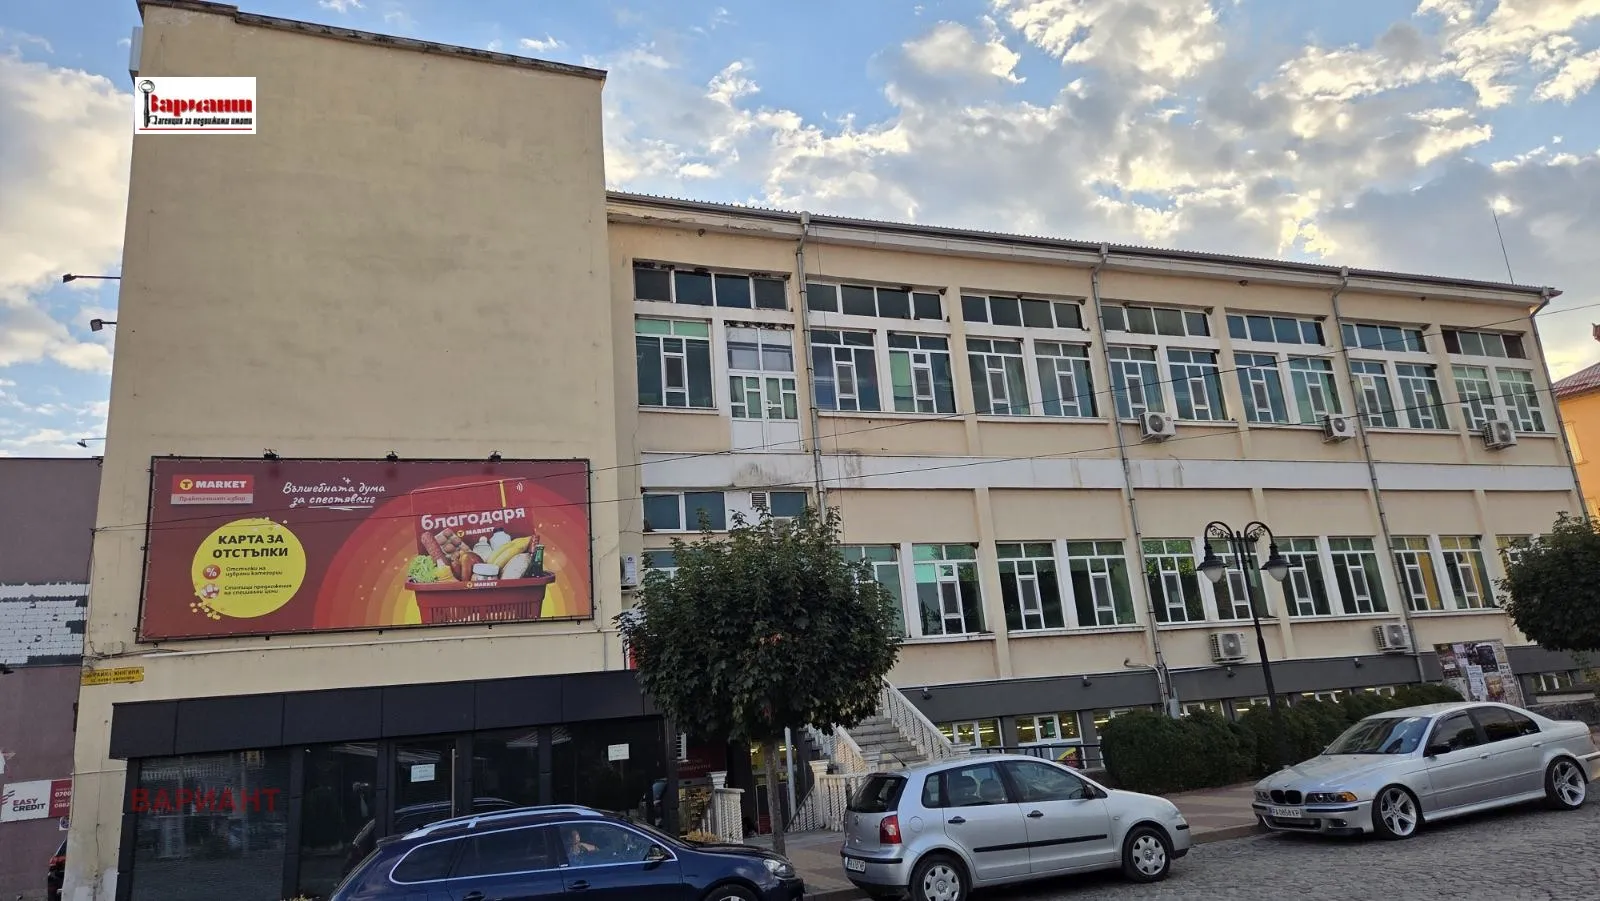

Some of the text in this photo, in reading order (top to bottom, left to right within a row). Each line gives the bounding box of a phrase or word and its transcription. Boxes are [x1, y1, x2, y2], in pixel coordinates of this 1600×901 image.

[195, 480, 247, 489] MARKET
[282, 482, 385, 495] Вълшебната дума
[289, 493, 376, 509] за спестяване
[421, 508, 525, 530] благодаря
[466, 527, 495, 535] MARKET
[218, 534, 284, 545] КАРТА ЗА
[212, 547, 288, 559] ОТСТЪПКИ
[12, 803, 46, 812] CREDIT
[13, 798, 38, 806] EASY
